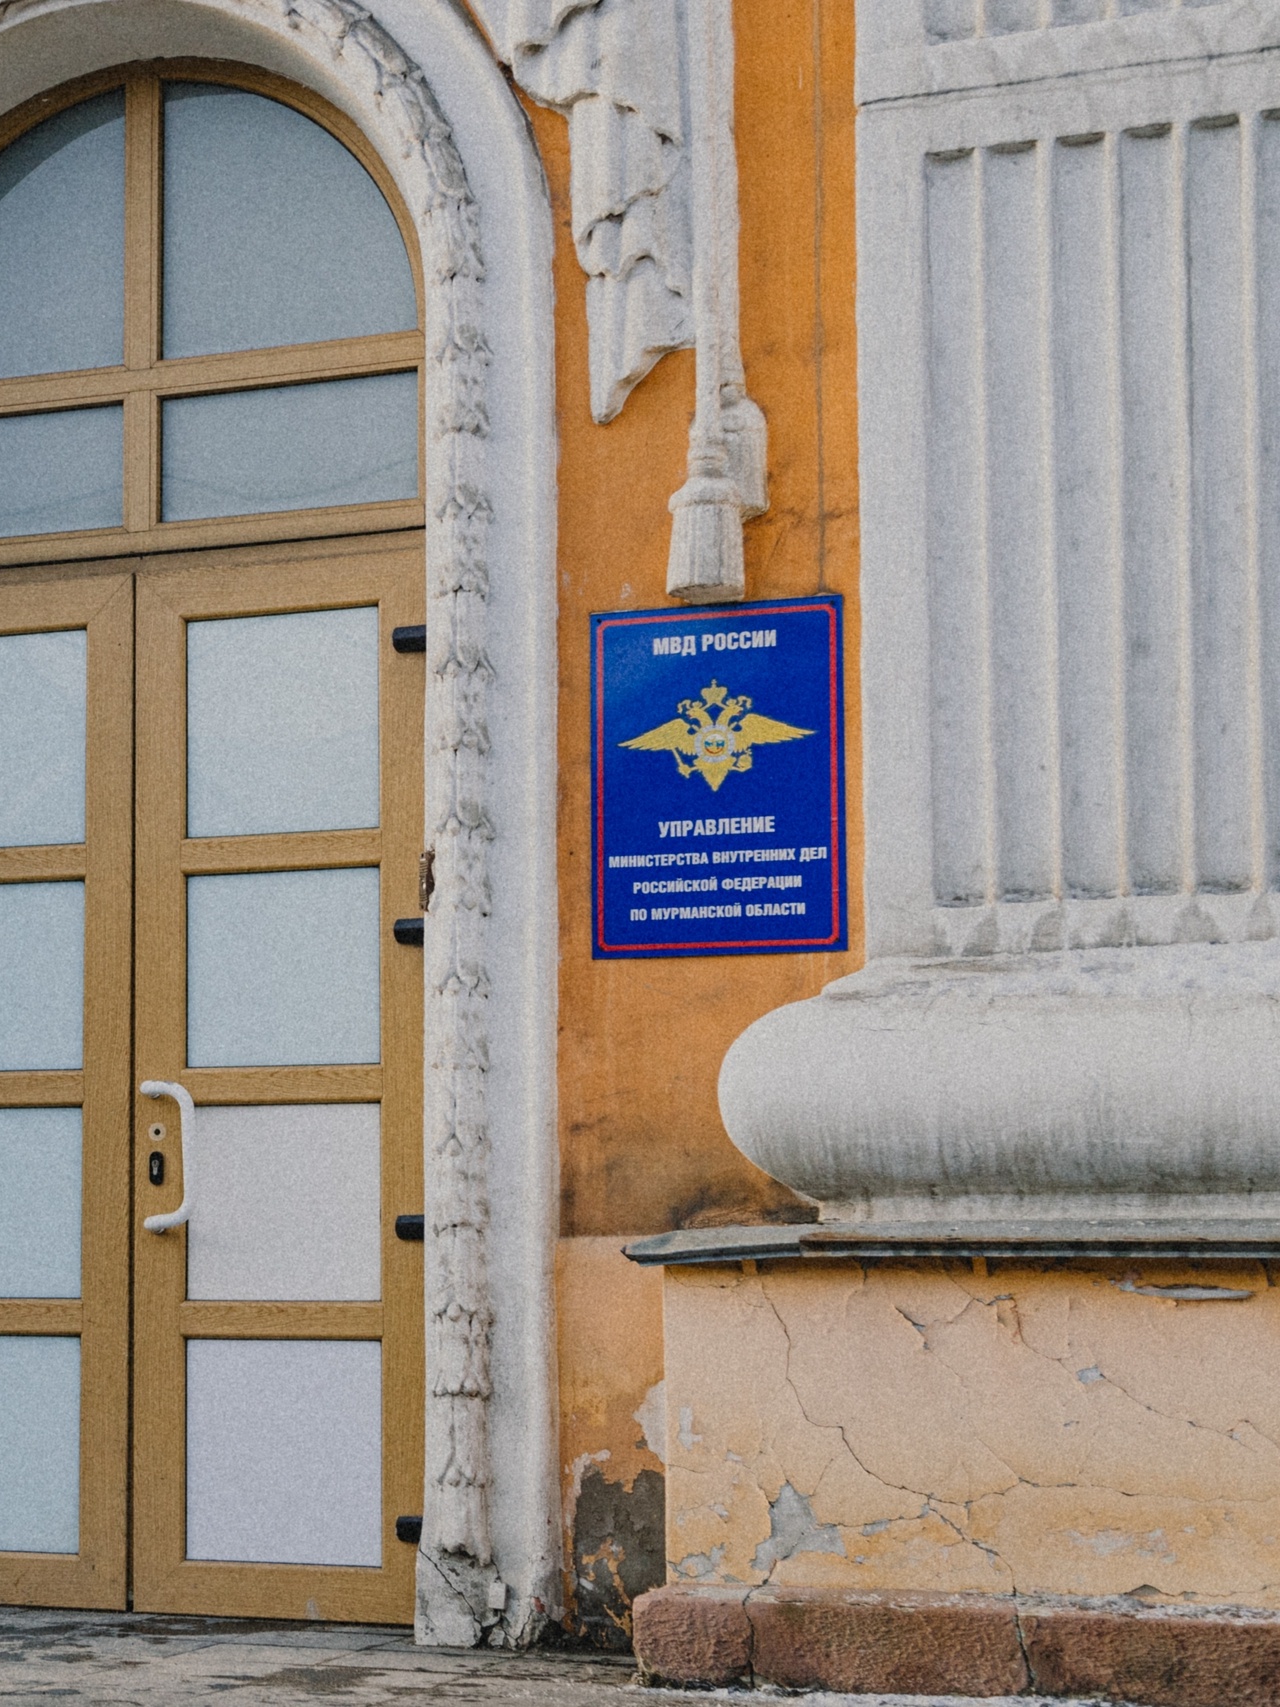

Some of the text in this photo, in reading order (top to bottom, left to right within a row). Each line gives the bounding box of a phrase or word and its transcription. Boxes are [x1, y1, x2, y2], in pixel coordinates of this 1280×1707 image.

[652, 629, 777, 657] МВД РОССИИ
[658, 815, 776, 838] УПРАВЛЕНИЕ
[608, 846, 828, 868] МИНИСТЕРСТВА ВНУТРЕННИХ ДЕЛ
[632, 874, 803, 894] РОССИЙСКОЙ ФЕДЕРАЦИИ
[630, 902, 806, 921] ПО МУРМАНСКОЙ ОБЛАСТИ
